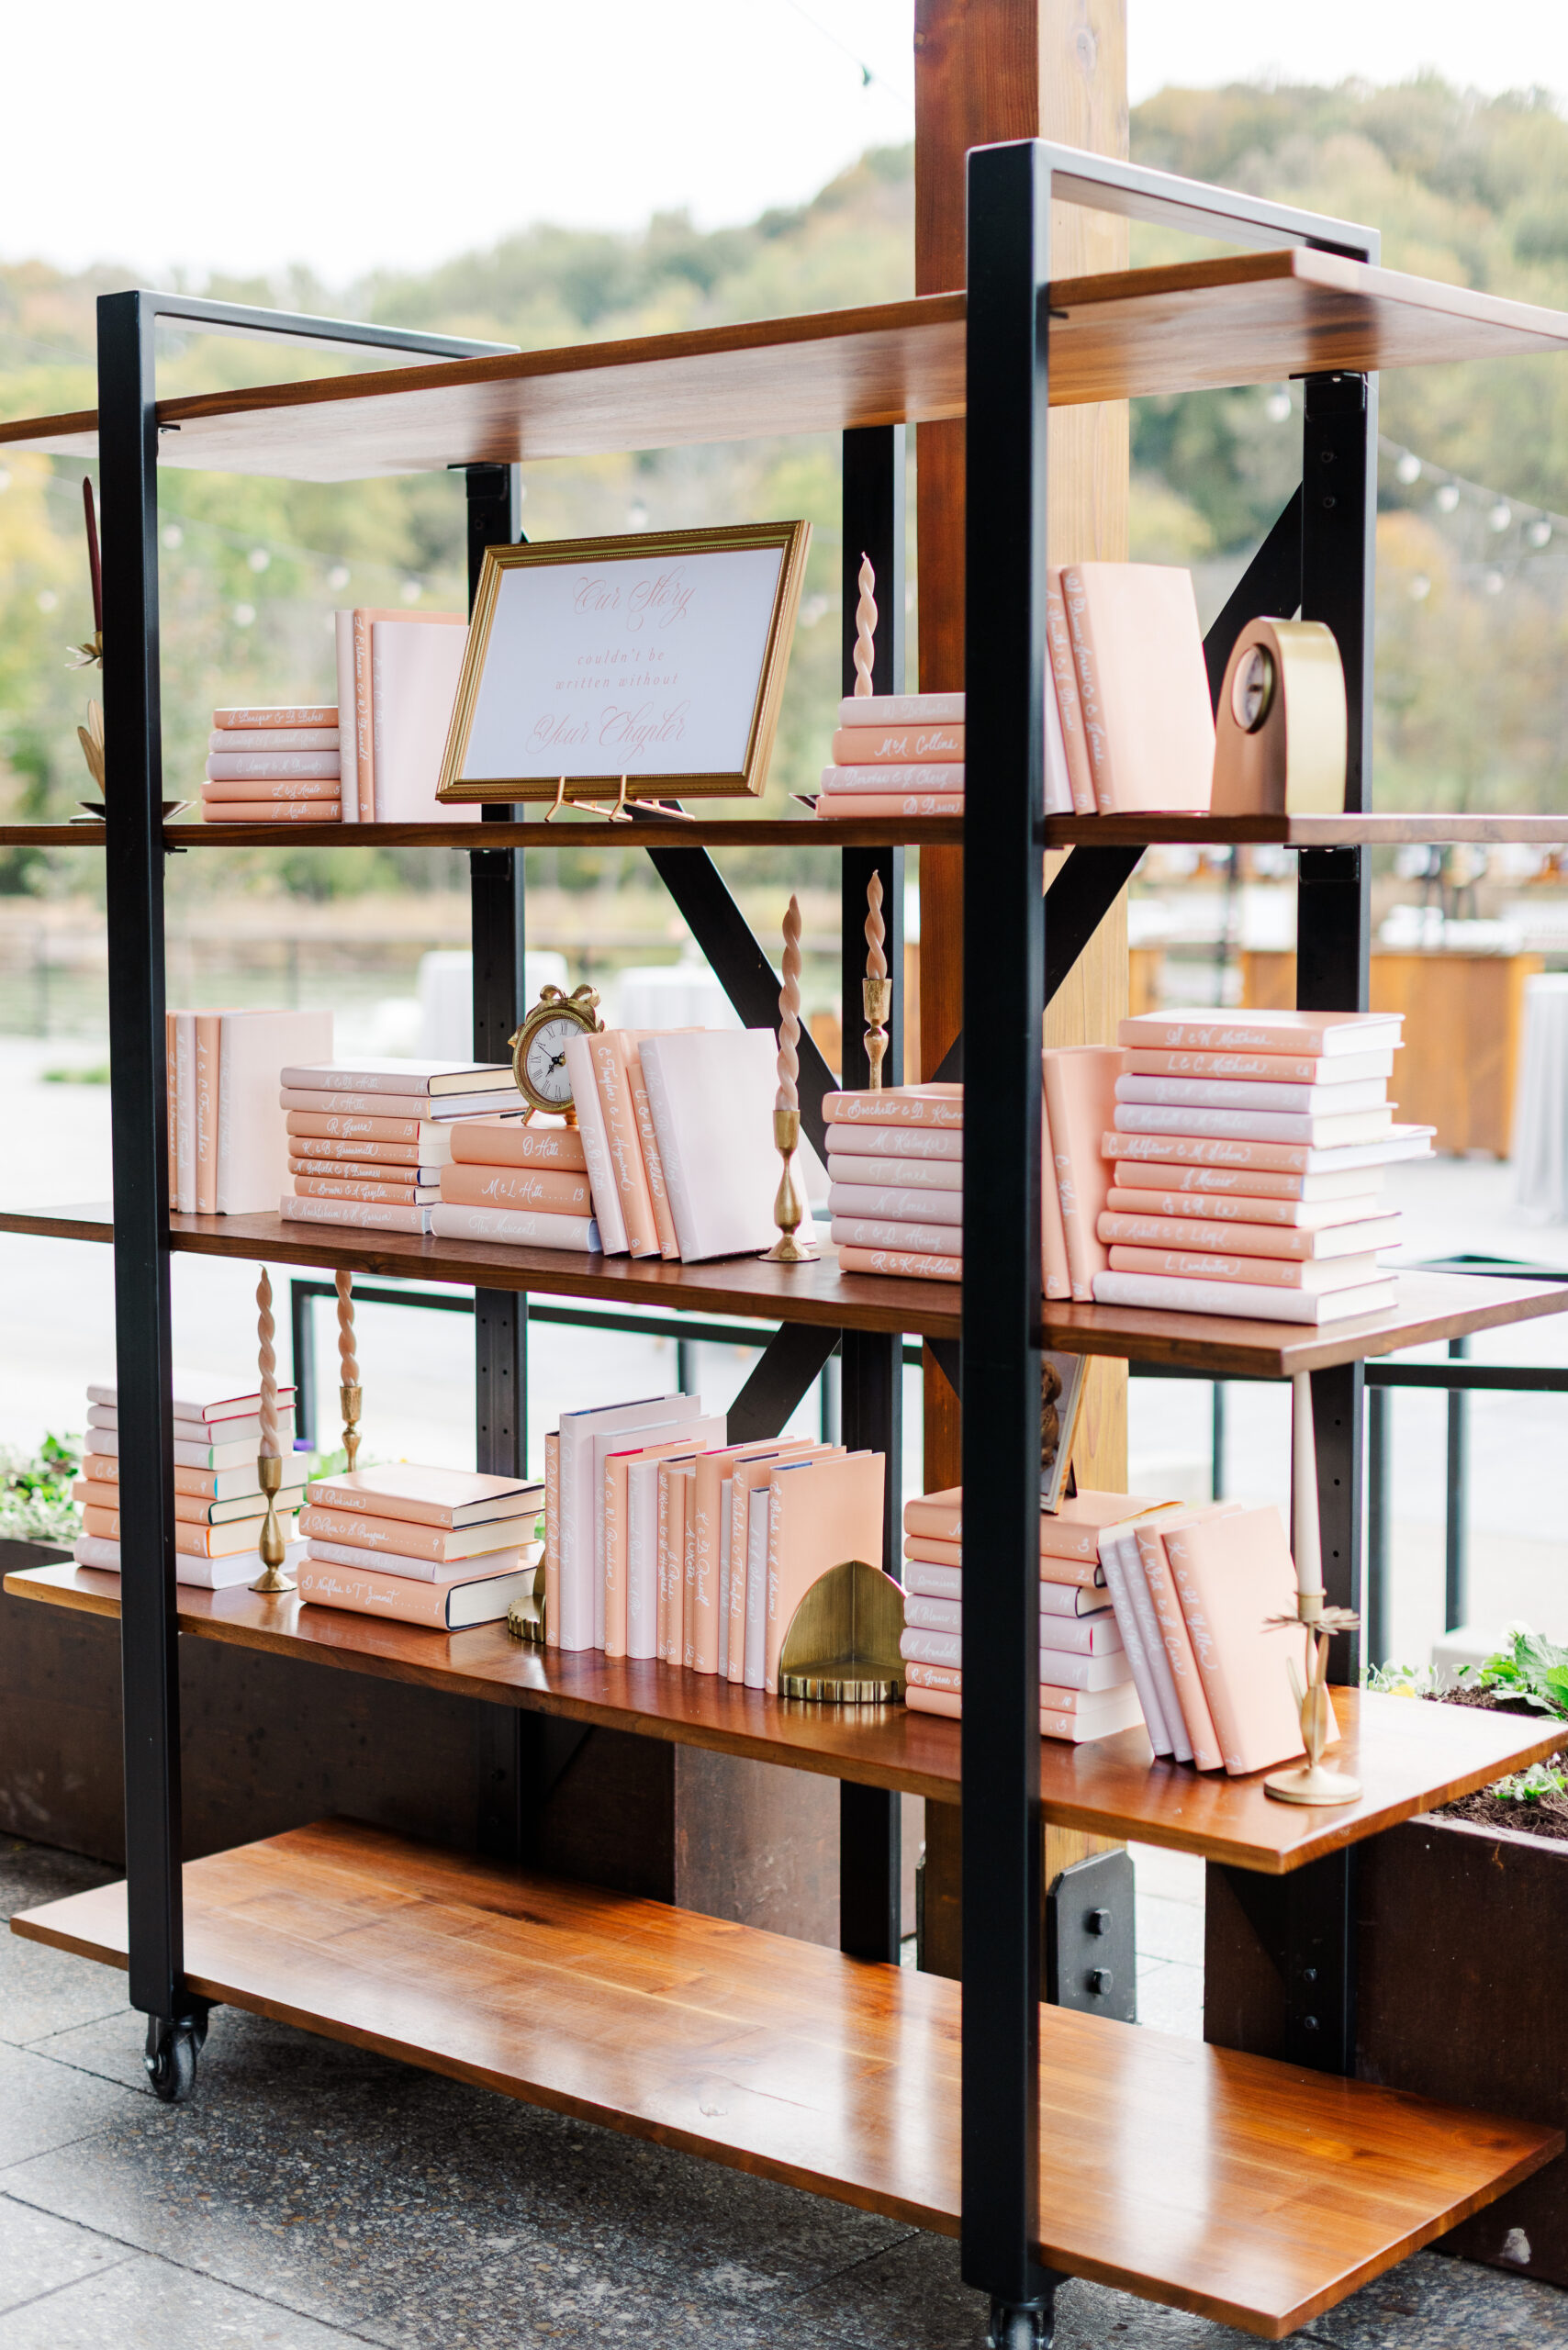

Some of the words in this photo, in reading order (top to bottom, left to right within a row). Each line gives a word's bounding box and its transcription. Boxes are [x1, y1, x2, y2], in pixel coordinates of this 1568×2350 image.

[574, 577, 620, 615] Our
[627, 565, 696, 632] Story
[577, 649, 642, 666] couldn't
[649, 647, 665, 662] be
[555, 676, 610, 690] written
[619, 673, 678, 688] without
[525, 714, 590, 755] Your
[599, 700, 691, 766] Chapter
